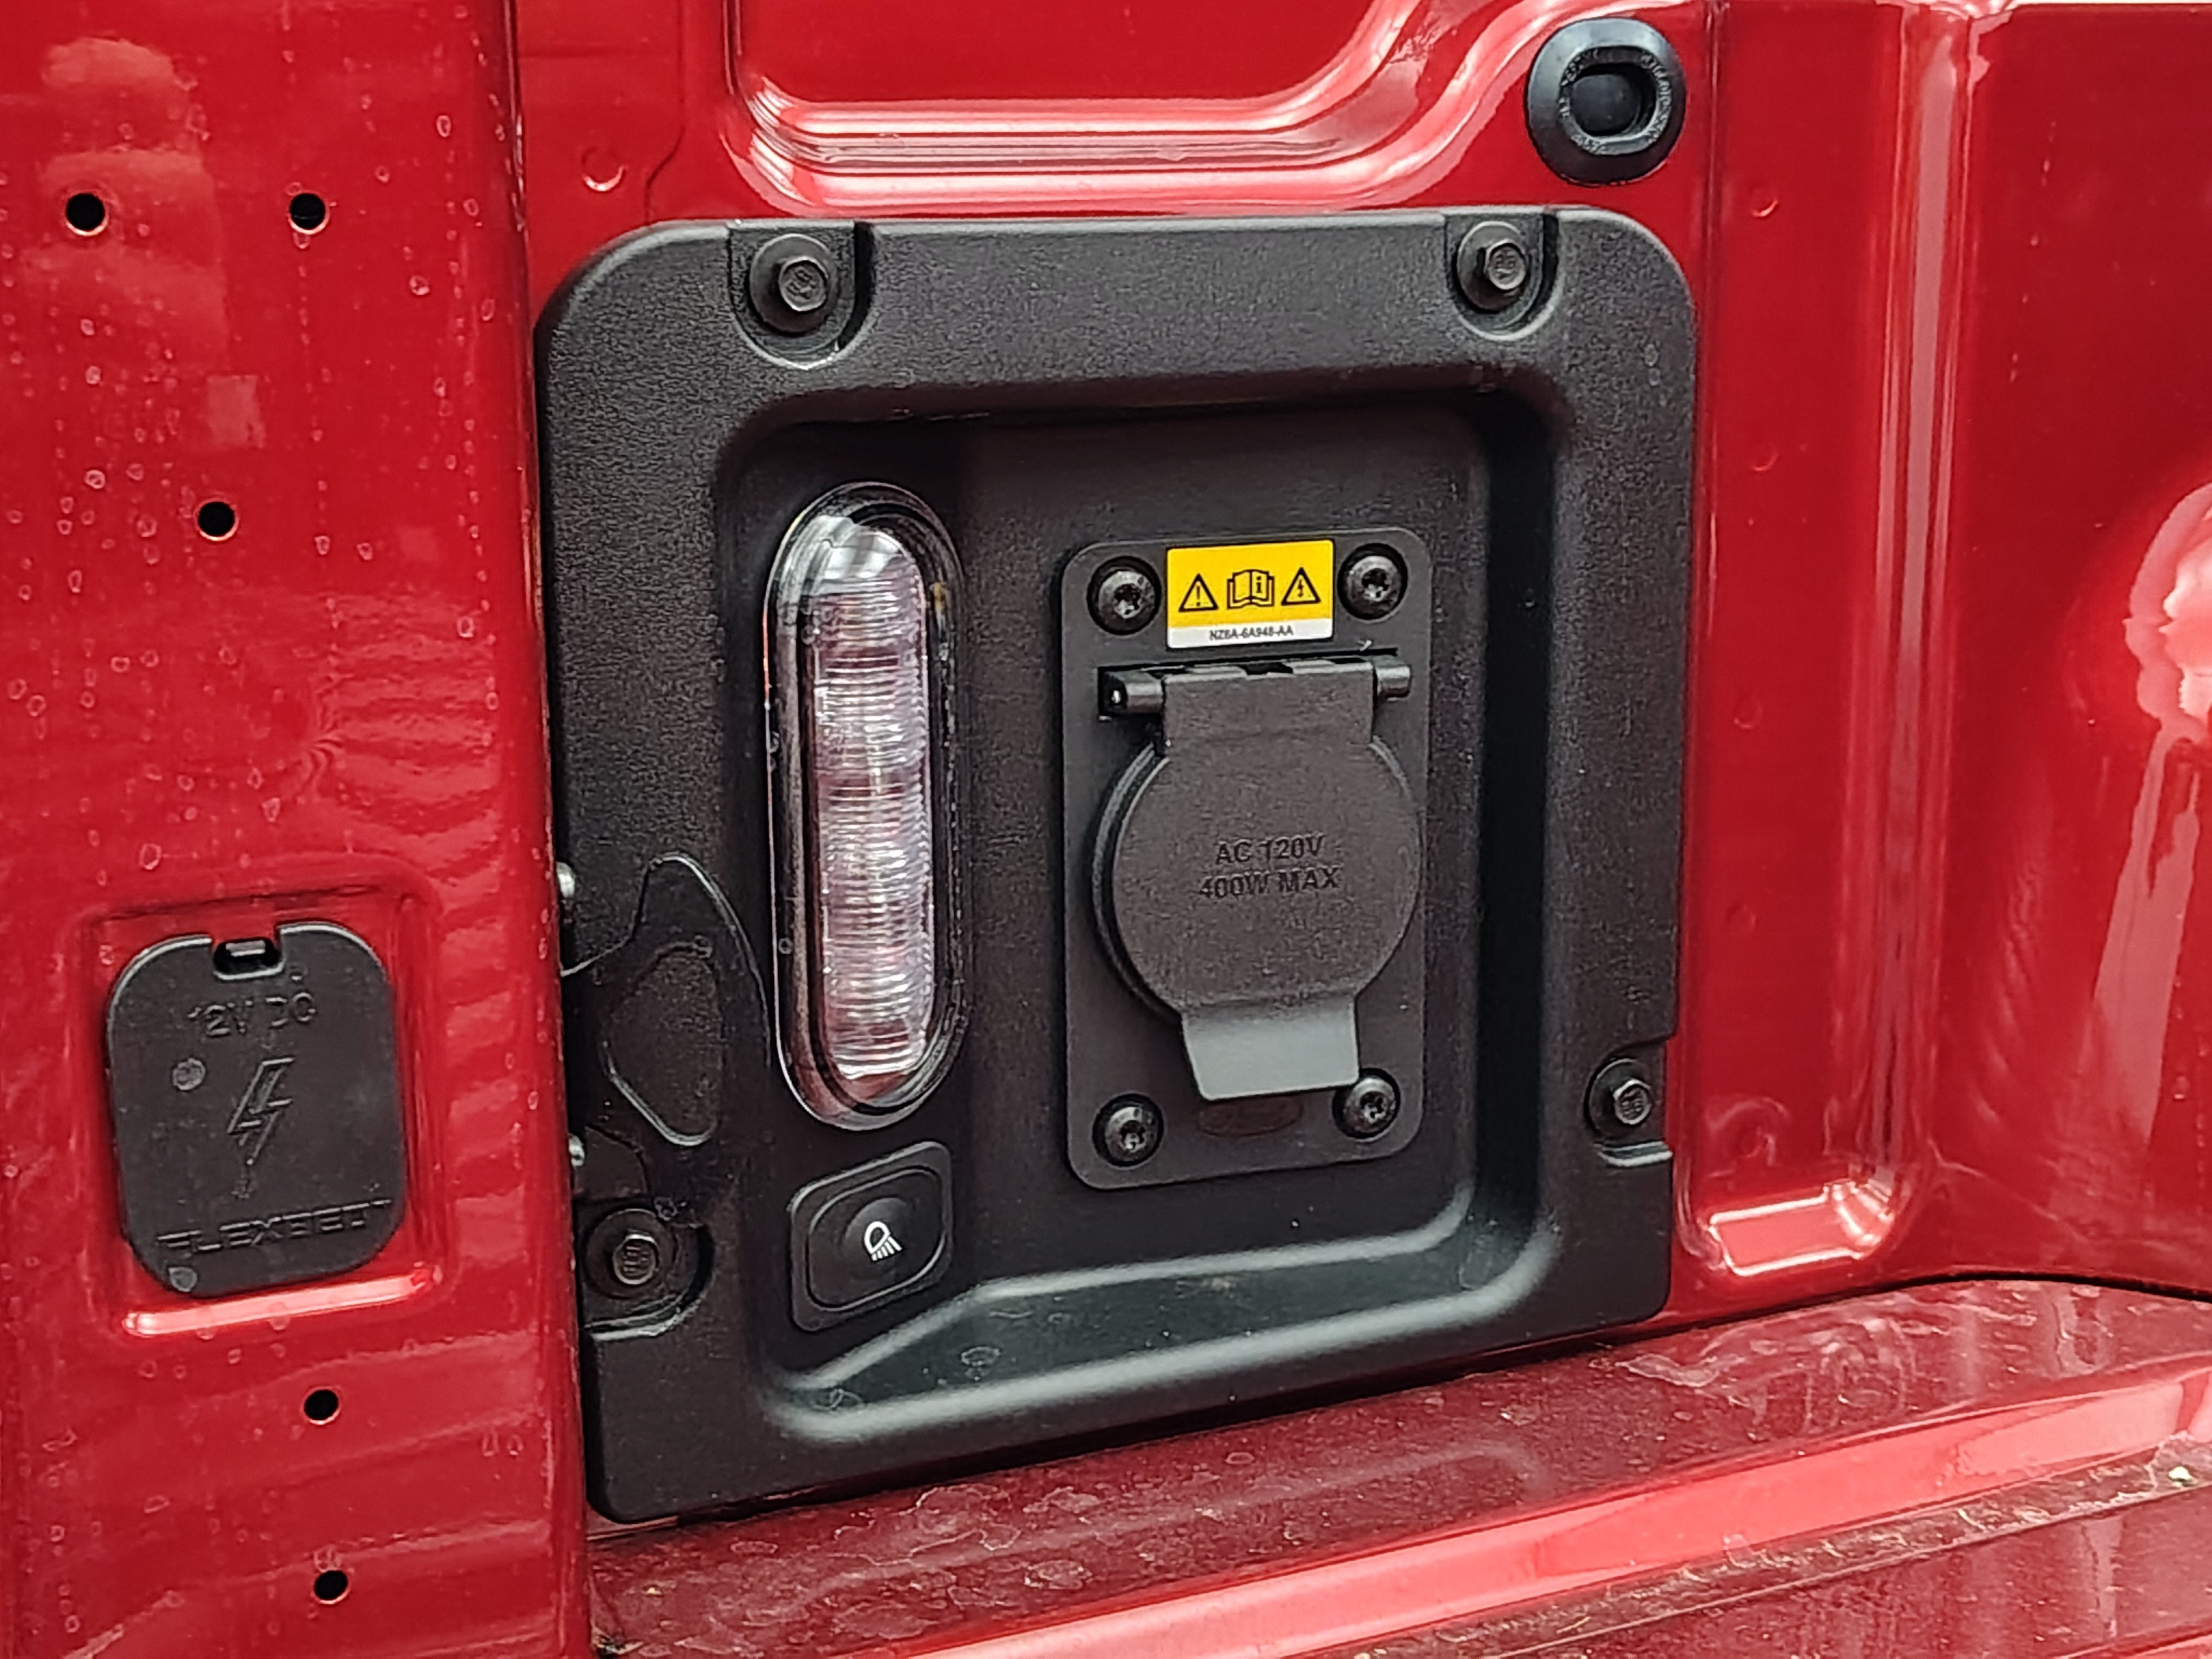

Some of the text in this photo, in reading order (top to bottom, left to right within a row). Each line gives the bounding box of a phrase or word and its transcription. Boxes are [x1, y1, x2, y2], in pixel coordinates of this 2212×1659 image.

[1216, 832, 1325, 865] AC 120V
[1199, 864, 1341, 898] 400W MAX
